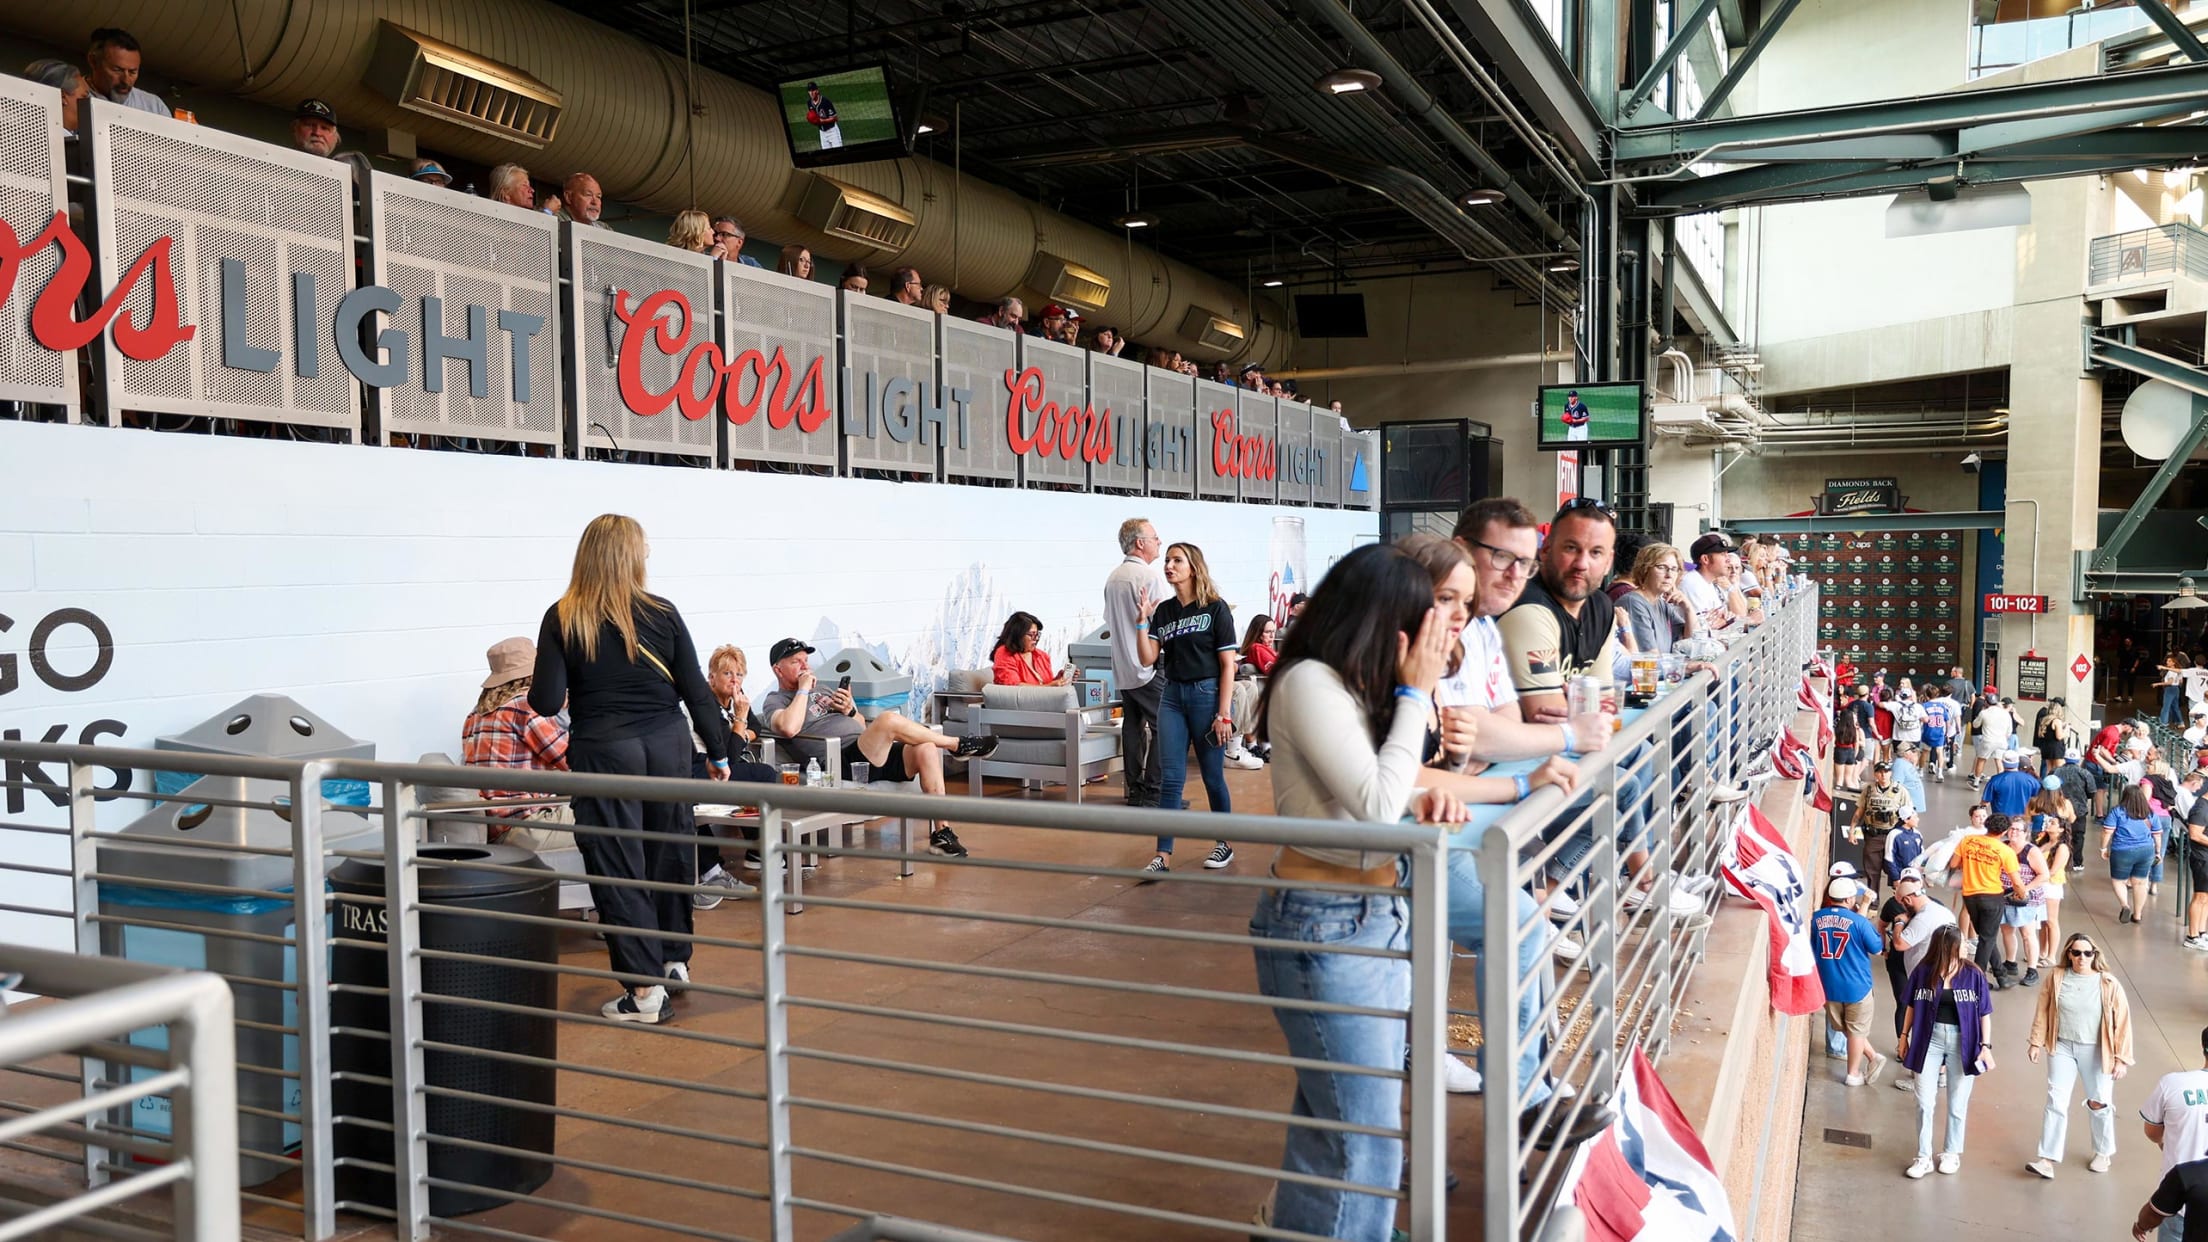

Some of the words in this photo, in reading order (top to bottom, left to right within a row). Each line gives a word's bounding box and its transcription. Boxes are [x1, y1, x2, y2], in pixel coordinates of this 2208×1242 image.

[222, 258, 544, 403] LIGHT
[615, 289, 832, 433] Coors
[842, 366, 974, 449] LIGHT
[1005, 366, 1114, 464] Coors
[1116, 415, 1193, 473] LIGHT
[1211, 408, 1276, 480] Coors
[1278, 441, 1329, 486] LIGHT
[1828, 480, 1870, 488] DIAMONDS
[1872, 479, 1893, 487] BACK
[1837, 490, 1881, 508] Fields
[1990, 596, 2037, 611] 101-102
[2075, 663, 2087, 673] 102
[342, 903, 389, 934] TRAS
[1815, 914, 1854, 932] BRYANT
[1818, 930, 1850, 960] 17
[2183, 1089, 2208, 1107] CA
